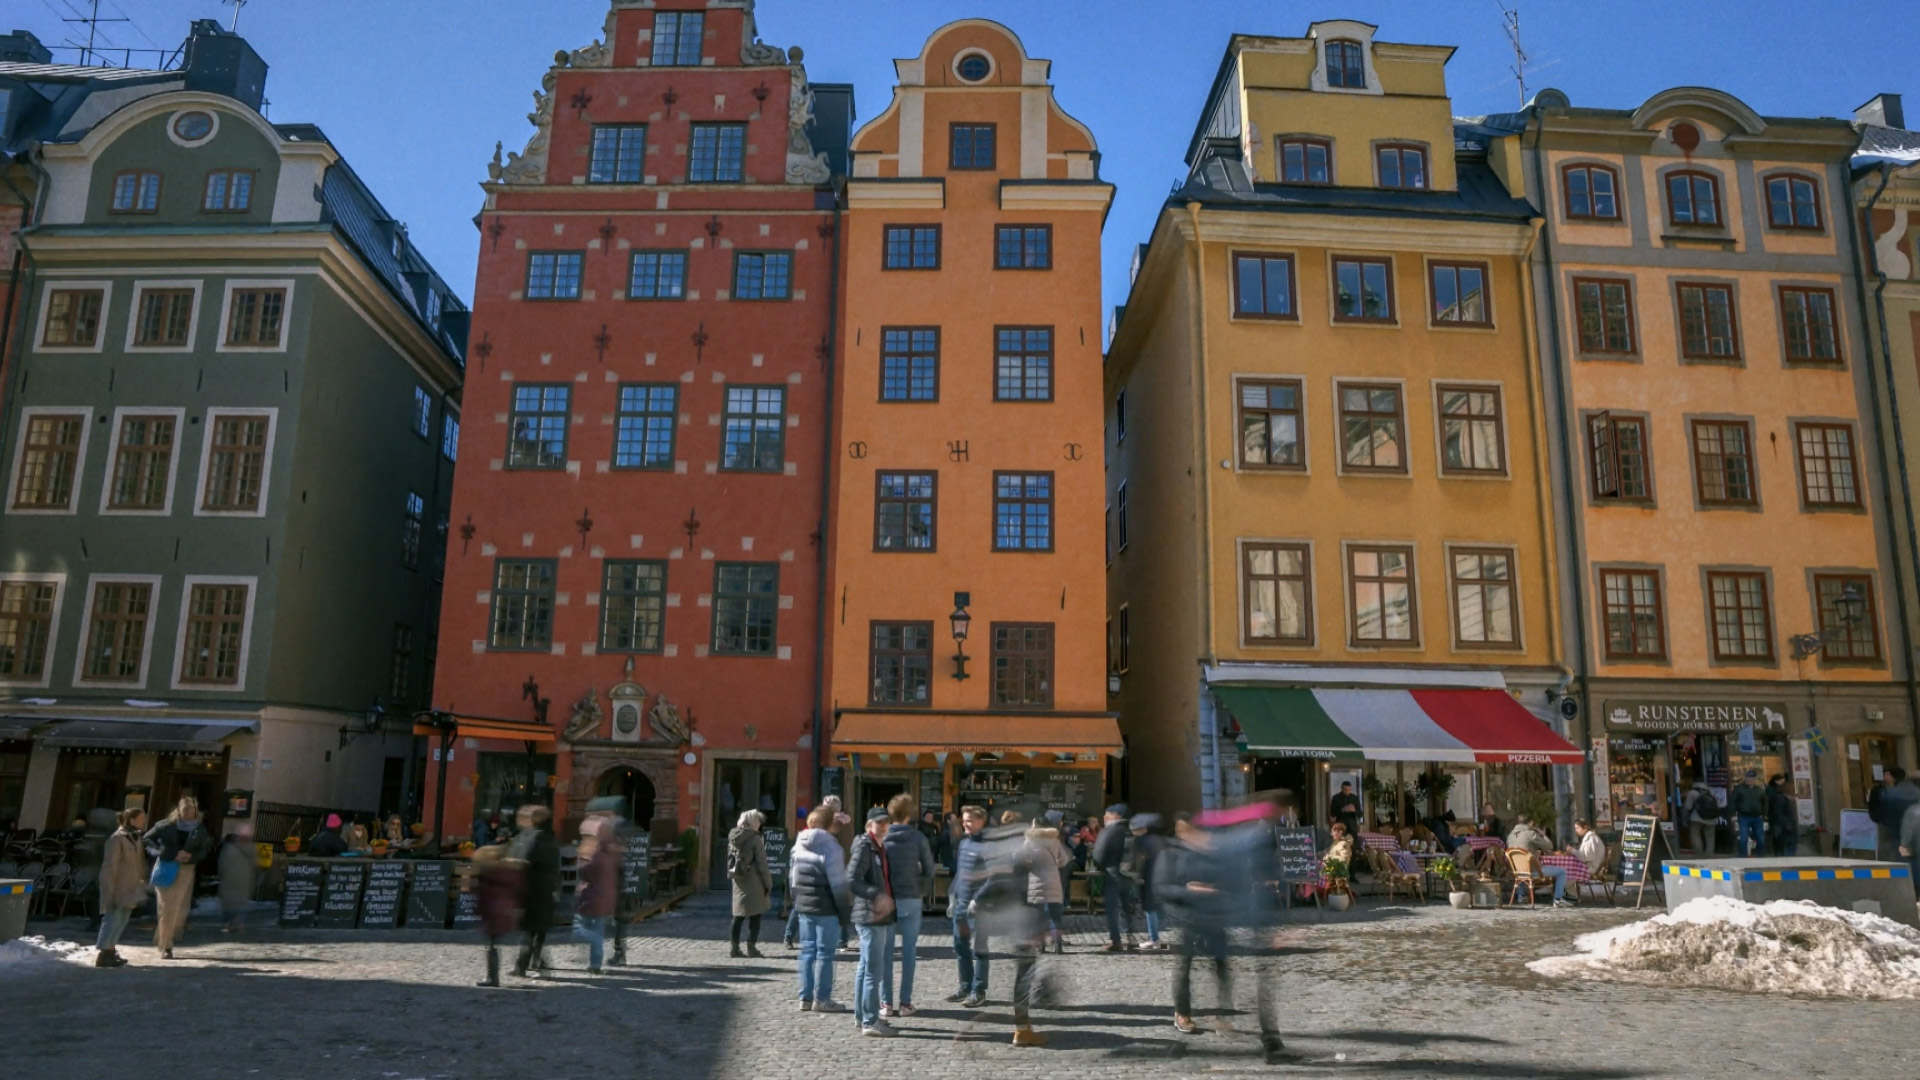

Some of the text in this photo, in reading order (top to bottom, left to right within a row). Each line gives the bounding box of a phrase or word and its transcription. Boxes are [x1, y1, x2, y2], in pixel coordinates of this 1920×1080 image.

[1638, 705, 1757, 720] RUNSTENEN
[1636, 720, 1763, 730] WOODEN HORSE MUSEM
[1279, 749, 1336, 759] TRATTORIA
[1508, 754, 1552, 763] PIZZERIA
[764, 830, 784, 841] TAKE
